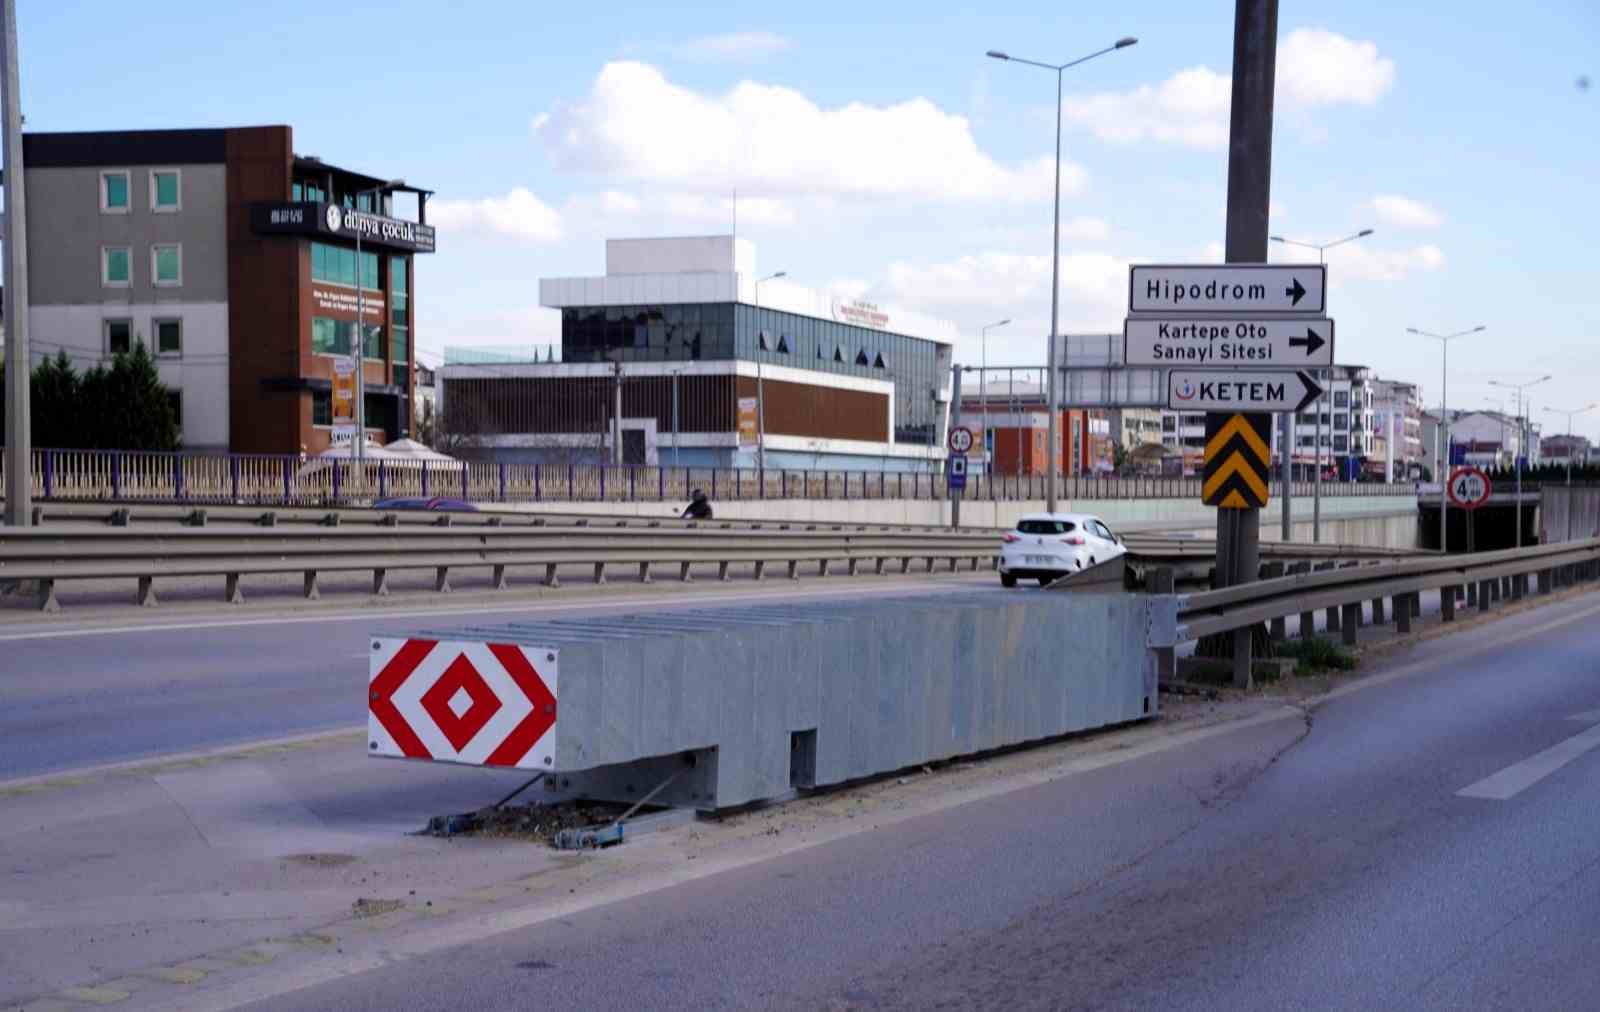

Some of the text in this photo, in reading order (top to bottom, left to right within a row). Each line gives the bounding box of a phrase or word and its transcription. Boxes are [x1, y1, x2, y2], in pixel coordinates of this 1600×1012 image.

[382, 220, 415, 243] çocuk
[1147, 279, 1266, 302] Hipodrom
[1158, 323, 1267, 341] Kartepe Oto
[1152, 343, 1273, 362] Sanayi Sitesi
[1200, 382, 1285, 401] KETEM
